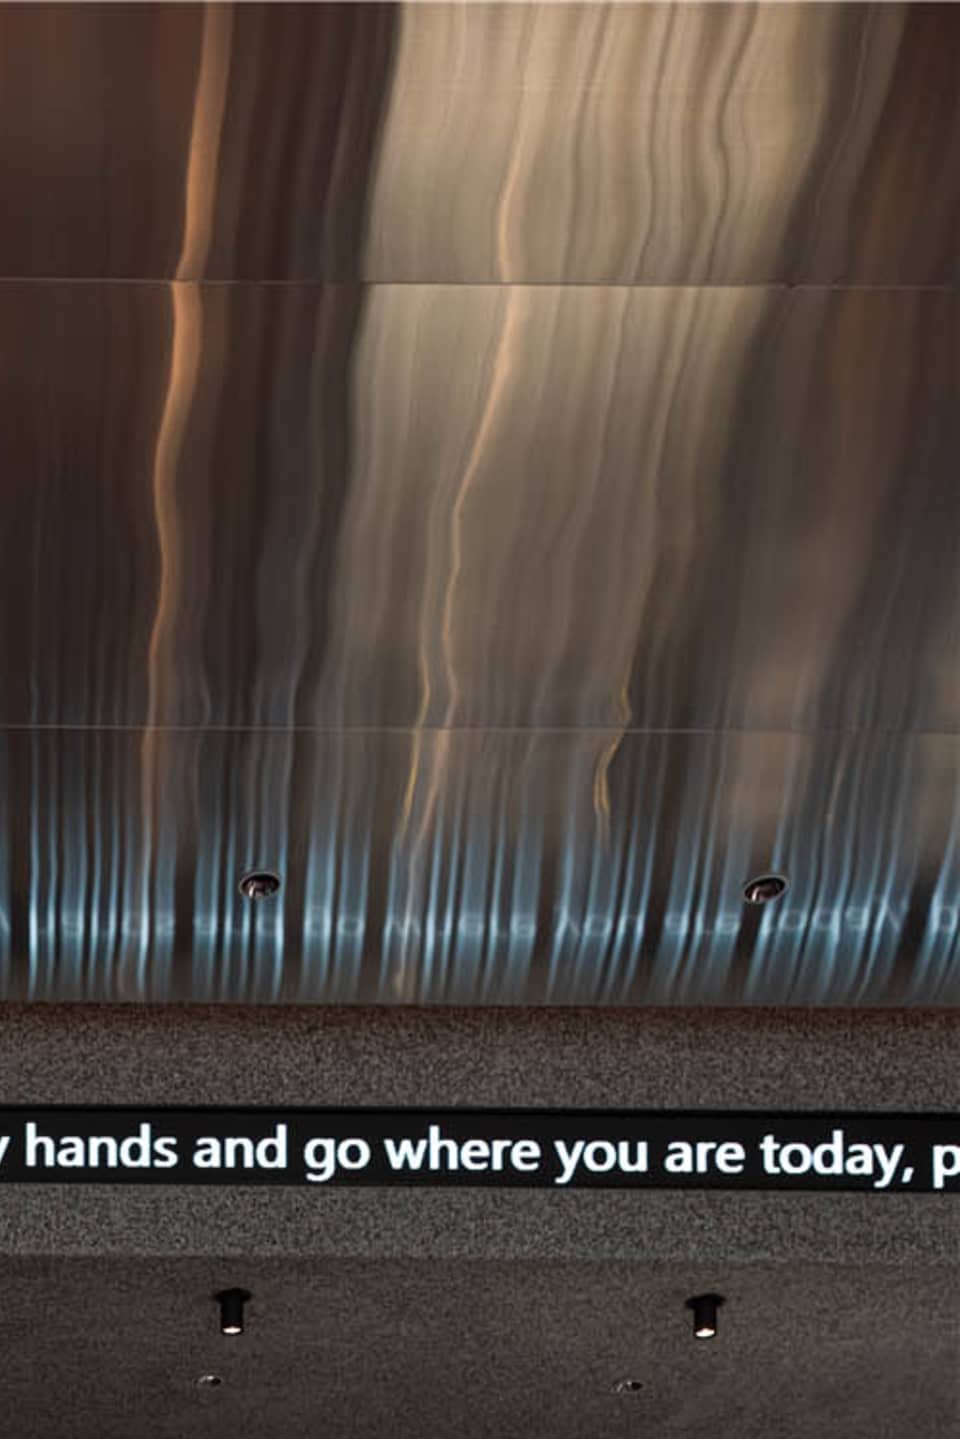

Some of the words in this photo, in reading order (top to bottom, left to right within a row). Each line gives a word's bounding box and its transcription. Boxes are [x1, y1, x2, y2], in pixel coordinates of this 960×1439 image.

[26, 1123, 179, 1168] hands
[193, 1124, 286, 1169] and
[304, 1138, 370, 1182] go
[384, 1126, 541, 1171] where
[554, 1141, 647, 1184] you
[665, 1142, 746, 1174] are
[760, 1130, 914, 1188] today,
